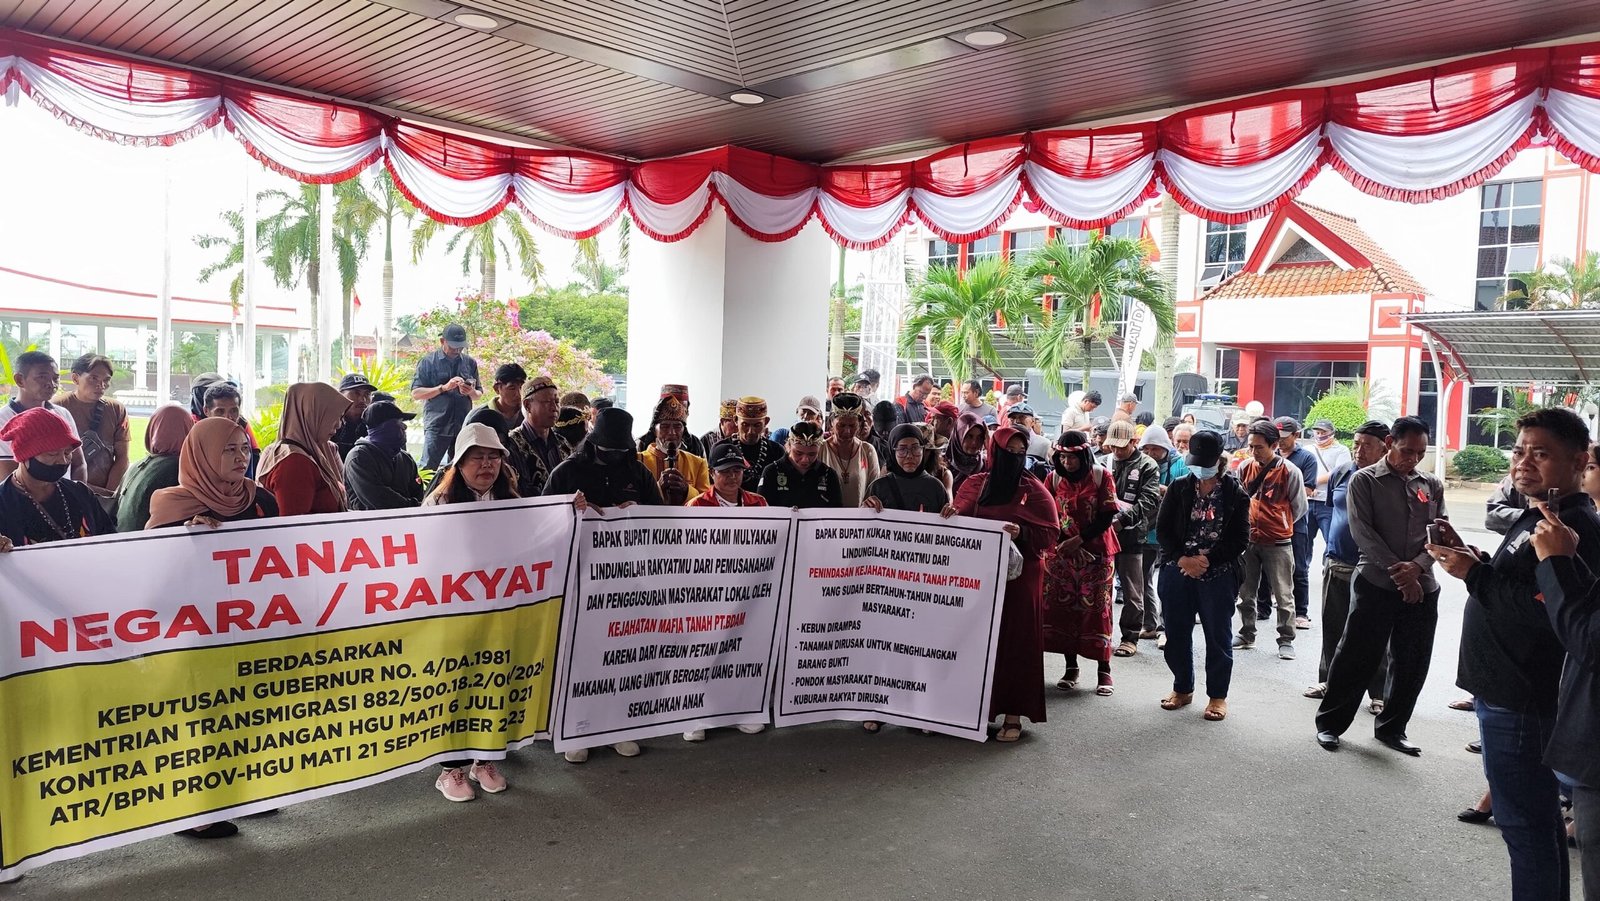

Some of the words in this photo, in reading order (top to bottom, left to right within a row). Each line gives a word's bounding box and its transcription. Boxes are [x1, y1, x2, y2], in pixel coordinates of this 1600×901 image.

[593, 531, 622, 548] BAPAK
[624, 530, 650, 546] BUPATI
[652, 529, 682, 544] KUKAR
[685, 529, 707, 544] YANG
[710, 529, 731, 544] KAMI
[734, 530, 778, 545] MULYAKAN
[816, 528, 837, 540] BAPAK
[840, 528, 864, 539] BUPATI
[866, 529, 890, 540] KUKAR
[893, 530, 913, 542] YANG
[915, 532, 933, 544] KAMI
[935, 534, 982, 550] BANGGAKAN
[213, 534, 418, 584] TANAH
[591, 561, 645, 580] LINDUNGILAH
[648, 559, 691, 576] RAKYATMU
[694, 559, 713, 574] DARI
[716, 557, 775, 573] PEMUSANAHAN
[842, 548, 888, 559] LINDUNGILAH
[890, 550, 930, 564] RAKYATMU
[932, 554, 949, 566] DARI
[809, 567, 853, 578] PENINDASAN
[855, 566, 895, 579] KEJAHATAN
[897, 570, 920, 583] MAFIA
[923, 573, 947, 585] TANAH
[949, 576, 980, 590] PT.BDAM
[587, 595, 604, 610] DAN
[606, 589, 667, 608] PENGGUSURAN
[669, 587, 723, 604] MASYARAKAT
[725, 585, 750, 601] LOKAL
[752, 583, 772, 598] OLEH
[822, 587, 840, 597] YANG
[842, 584, 864, 595] SUDAH
[866, 585, 931, 602] BERTAHUN-TAHUN
[933, 594, 963, 607] DIALAMI
[20, 594, 302, 658] NEGARA
[365, 561, 552, 614] RAKYAT
[862, 603, 910, 618] MASYARAKAT
[608, 619, 657, 637] KEJAHATAN
[659, 618, 683, 634] MAFIA
[686, 615, 712, 632] TANAH
[714, 613, 746, 630] PT.BDAM
[801, 622, 825, 633] KEBUN
[827, 620, 861, 632] DIRAMPAS
[238, 639, 403, 677] BERDASARKAN
[603, 648, 637, 666] KARENA
[639, 645, 657, 660] DARI
[659, 644, 687, 658] KEBUN
[689, 641, 717, 657] PETANI
[719, 638, 742, 654] DAPAT
[799, 641, 833, 651] TANAMAN
[835, 639, 864, 650] DIRUSAK
[866, 639, 891, 650] UNTUK
[893, 643, 957, 660] MENGHILANGKAN
[798, 659, 827, 669] BARANG
[828, 657, 849, 668] BUKTI
[99, 686, 246, 728] KEPUTUSAN
[253, 667, 374, 699] GUBERNUR
[381, 663, 416, 682] NO.
[423, 650, 510, 678] 4/DA.1981
[572, 678, 617, 698] MAKANAN,
[620, 675, 641, 691] UANG
[643, 671, 671, 688] UNTUK
[672, 668, 709, 683] BEROBAT,
[711, 665, 733, 680] UANG
[736, 663, 763, 678] UNTUK
[796, 676, 824, 687] PONDOK
[826, 674, 872, 686] MASYARAKAT
[874, 676, 926, 692] DIHANCURKAN
[628, 696, 681, 718] SEKOLAHKAN
[683, 693, 705, 710] ANAK
[794, 694, 827, 705] KUBURAN
[829, 692, 856, 702] RAKYAT
[858, 692, 888, 705] DIRUSAK
[12, 725, 178, 778] KEMENTRIAN
[186, 696, 356, 742] TRANSMIGRASI
[40, 760, 147, 799] KONTRA
[156, 724, 342, 773] PERPANJANGAN
[350, 716, 393, 735] HGU
[401, 704, 443, 727] MATI
[449, 698, 459, 713] 6
[464, 696, 504, 711] JULI
[50, 785, 164, 826] ATR/BPN
[173, 756, 293, 797] PROV-HGU
[301, 747, 351, 770] MATI
[358, 742, 377, 759] 21
[384, 719, 493, 753] SEPTEMBER
